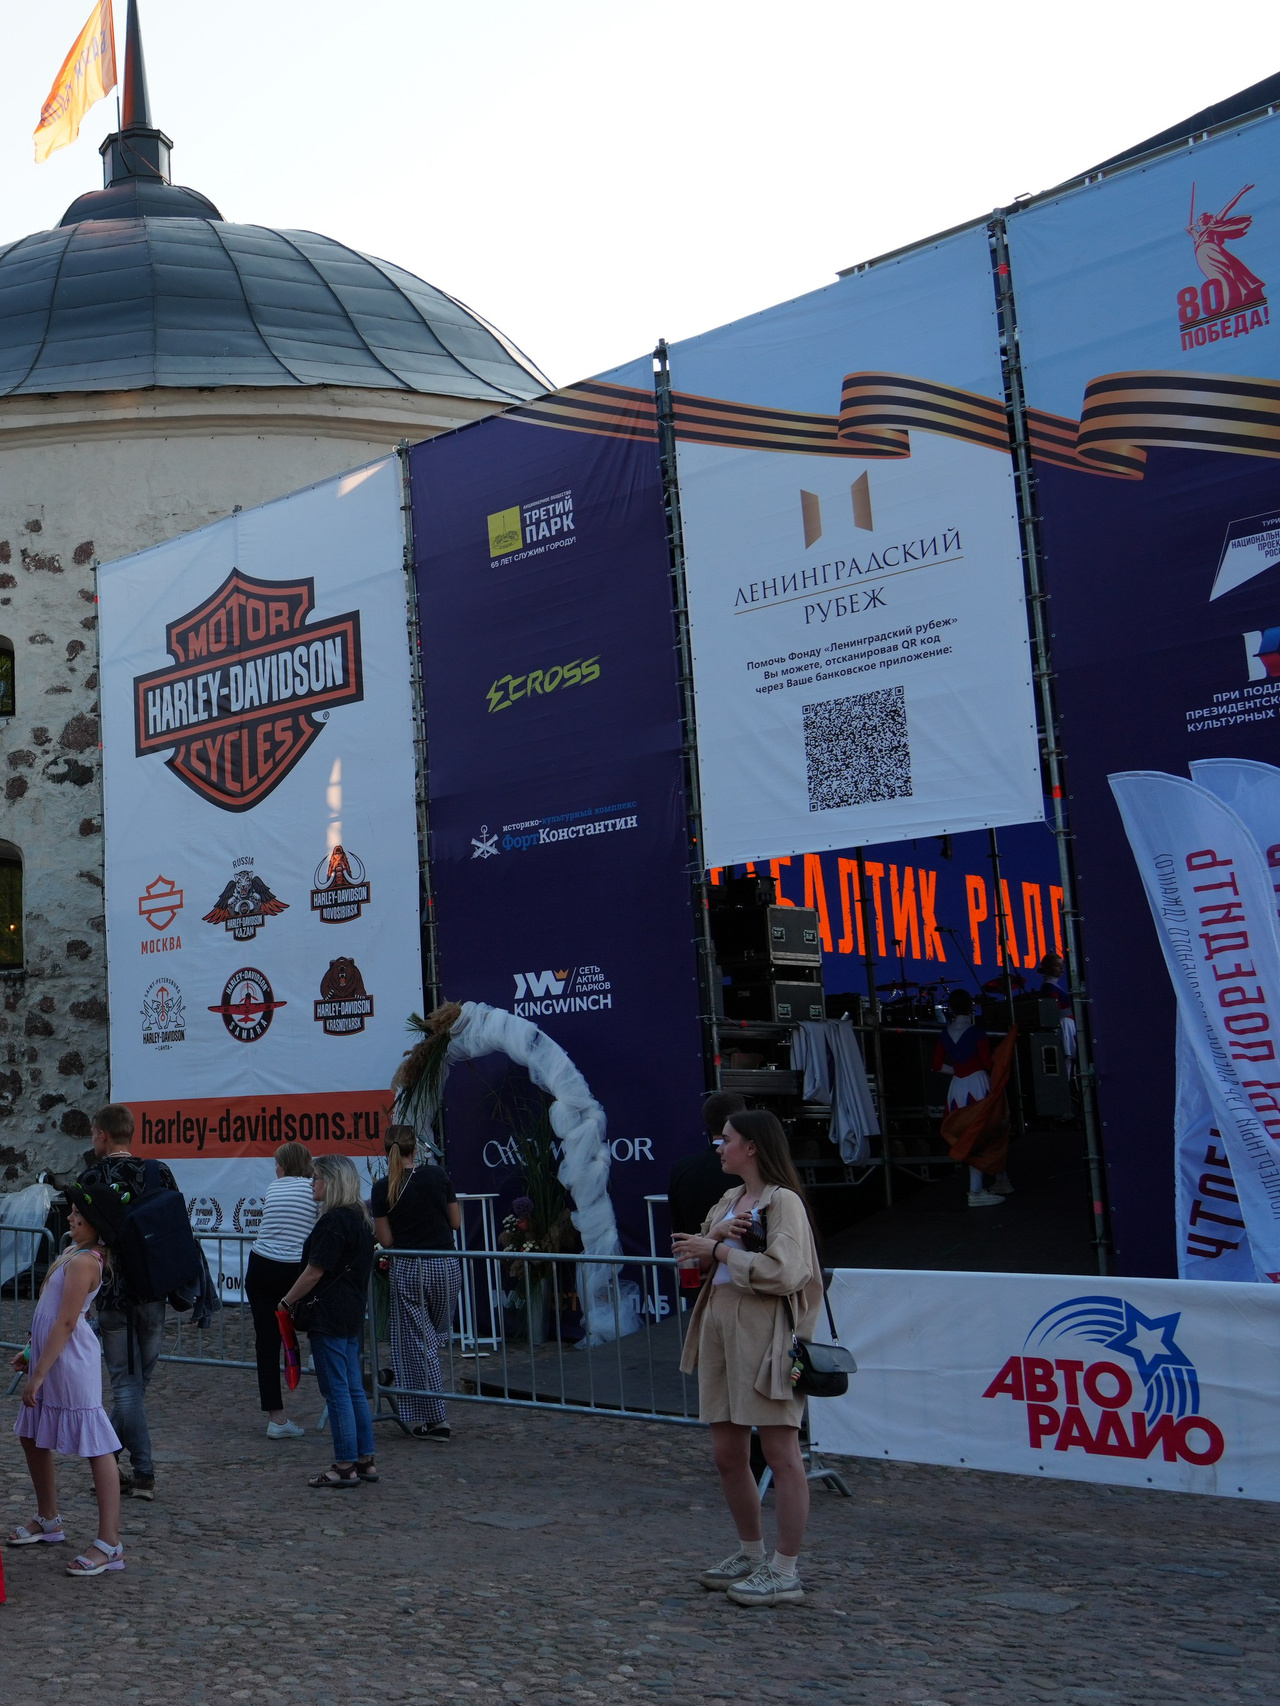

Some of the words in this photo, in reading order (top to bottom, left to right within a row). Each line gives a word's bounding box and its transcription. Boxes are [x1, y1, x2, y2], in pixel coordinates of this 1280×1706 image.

[1176, 278, 1225, 325] 80
[1180, 306, 1271, 351] ПОБЕДА!
[523, 495, 573, 525] ТРЕТИЙ
[525, 512, 575, 544] ПАРК
[490, 561, 499, 569] 65
[500, 556, 513, 566] ЛЕТ
[513, 547, 545, 561] СЛУЖИМ
[546, 536, 576, 551] ГОРОДУ!
[1265, 548, 1280, 558] РОС
[734, 527, 963, 607] ЛЕНИНГРАДСКИЙ
[804, 587, 888, 625] РУБЕЖ
[188, 592, 289, 660] MOTOR
[747, 655, 786, 671] Помочь
[788, 647, 822, 662] Фонду
[824, 625, 913, 653] «Ленинградский
[915, 616, 959, 635] рубеж»
[764, 671, 778, 681] Вы
[781, 661, 823, 676] можете,
[825, 644, 899, 667] отсканировав
[901, 638, 918, 650] QR
[920, 634, 941, 646] код
[756, 682, 784, 695] через
[786, 676, 813, 689] Ваше
[815, 663, 877, 681] банковское
[879, 646, 953, 669] приложение:
[148, 637, 343, 734] HARLEY-DAVIDSON
[1213, 690, 1240, 703] ПРИ
[1187, 709, 1275, 732] КУЛЬТУРНЫХ
[190, 718, 293, 792] CYCLES
[503, 808, 593, 832] историко-культурный
[594, 801, 637, 815] комплекс
[232, 856, 254, 869] RUSSIA
[313, 886, 367, 906] HARLEY-DAVIDSON
[323, 904, 358, 919] NOVOSIBIRSK
[235, 927, 255, 937] KAZAN
[141, 936, 182, 955] МОСКВА
[576, 973, 605, 984] АКТИВ
[579, 965, 601, 975] СЕТЬ
[226, 970, 268, 995] HARLEY-DAVIDSON
[576, 982, 611, 993] ПАРКОВ
[317, 1000, 371, 1017] HARLEY-DAVIDSON
[514, 993, 612, 1017] KINGWINCH
[143, 1030, 185, 1044] HARLEY-DAVIDSON
[229, 1019, 268, 1039] SAMARA
[141, 1107, 380, 1150] harley-davidsons.ru
[195, 1207, 213, 1217] ЛУЧШИЙ
[195, 1218, 210, 1226] ДИЛЕР
[245, 1218, 261, 1227] ДИЛЕР
[982, 1355, 1133, 1409] АВТО
[1027, 1402, 1225, 1466] РАДИО
